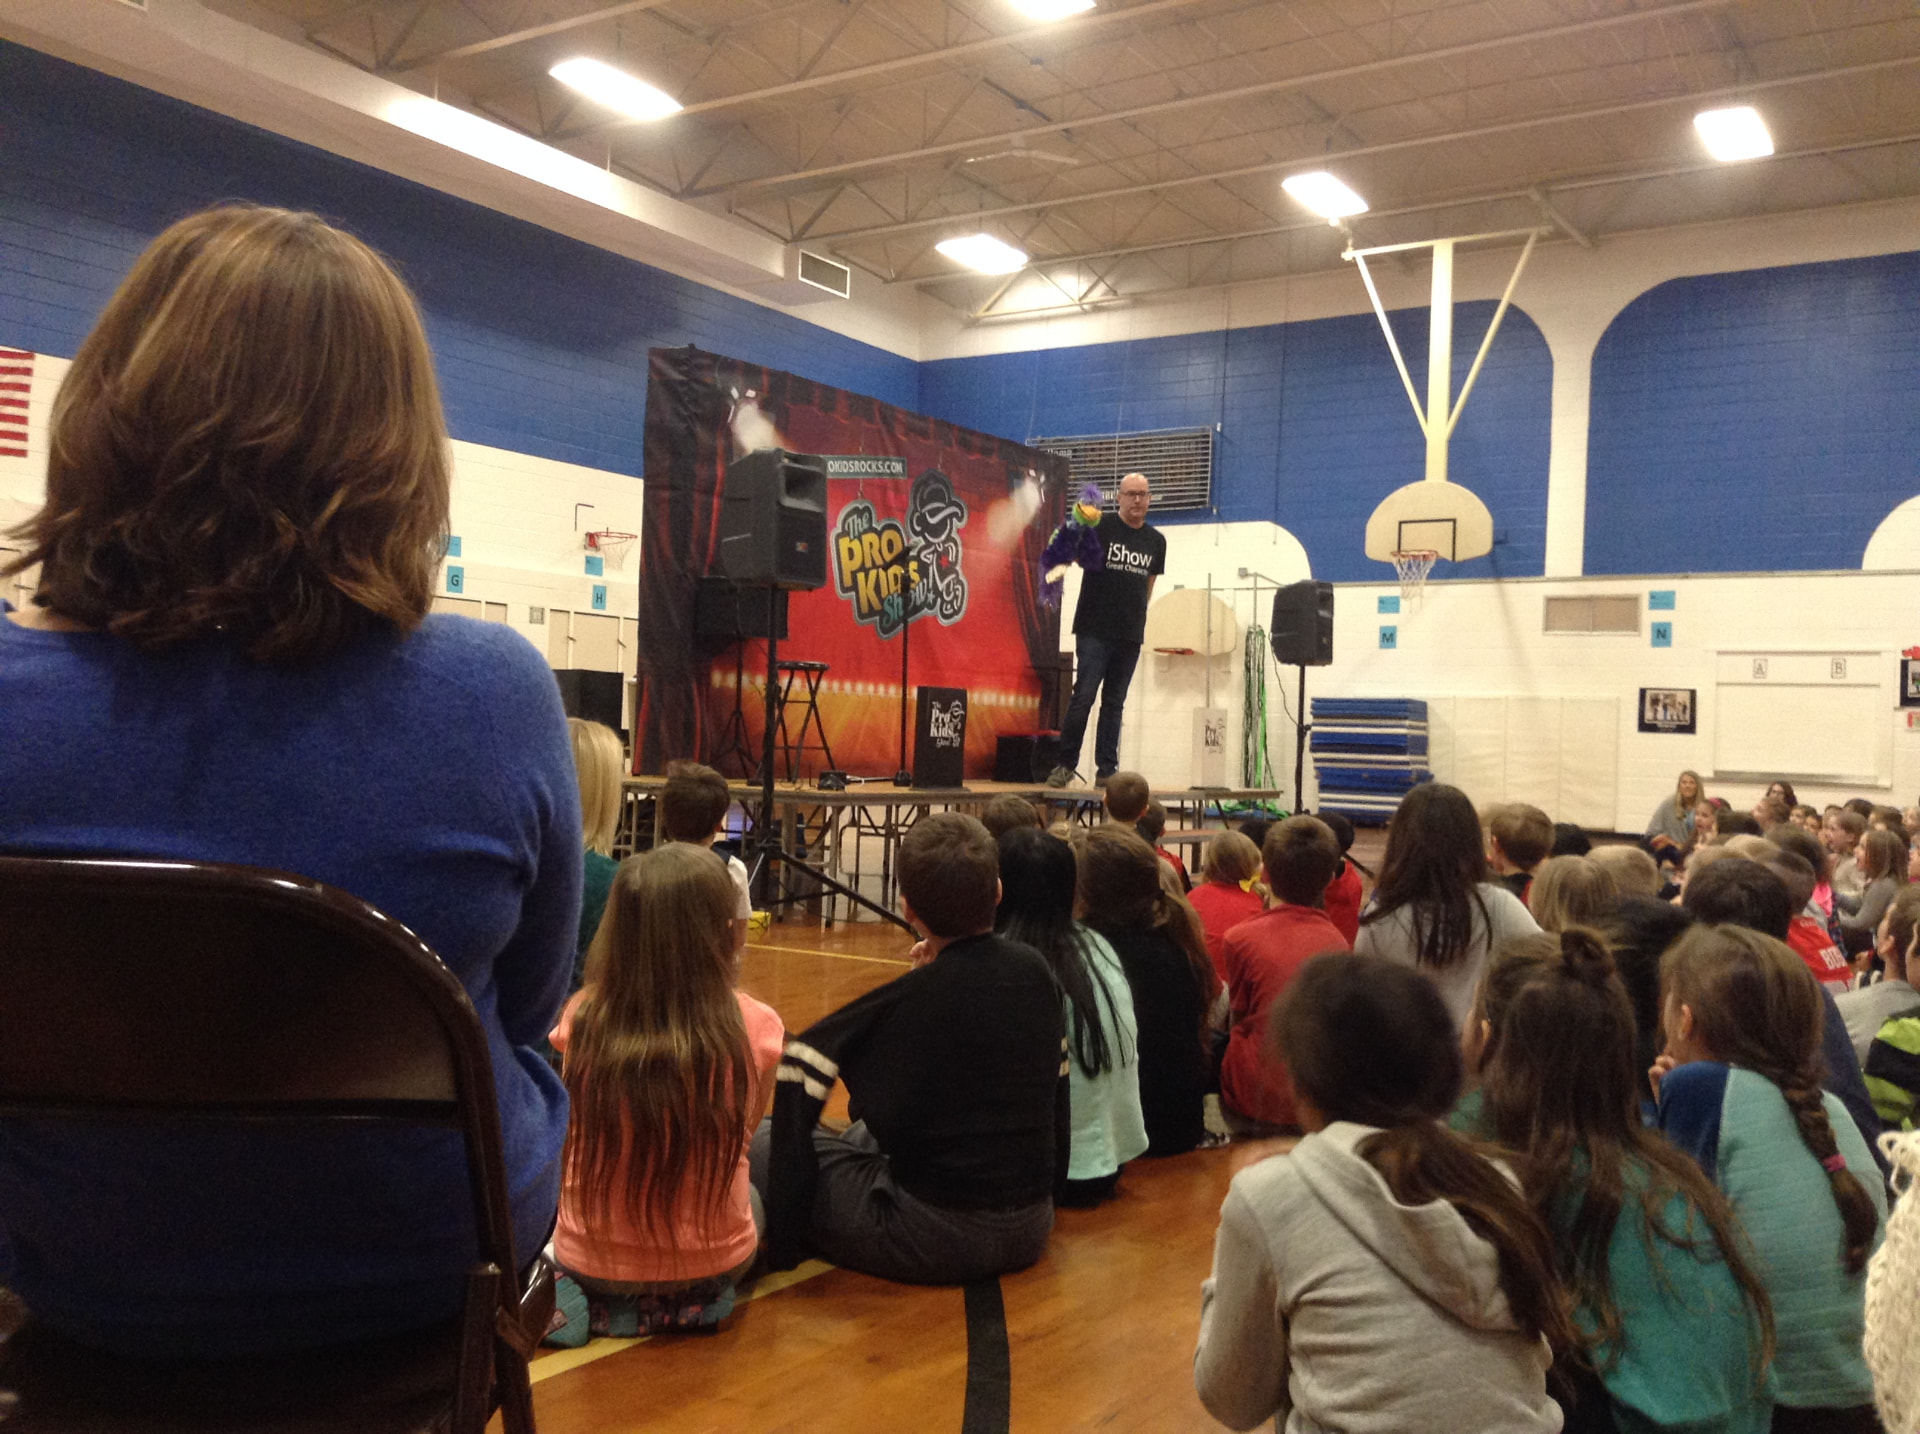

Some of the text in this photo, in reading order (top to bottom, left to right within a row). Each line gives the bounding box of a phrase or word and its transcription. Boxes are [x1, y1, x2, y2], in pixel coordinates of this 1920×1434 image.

[845, 512, 870, 539] The
[838, 529, 904, 587] PRO
[1107, 542, 1152, 568] iShow
[451, 575, 460, 587] G
[596, 593, 603, 603] H
[1382, 633, 1394, 643] M
[1656, 628, 1667, 639] N
[1755, 663, 1765, 675] A
[1834, 663, 1843, 675] B
[931, 709, 951, 722] Pro
[930, 722, 954, 738] Kids
